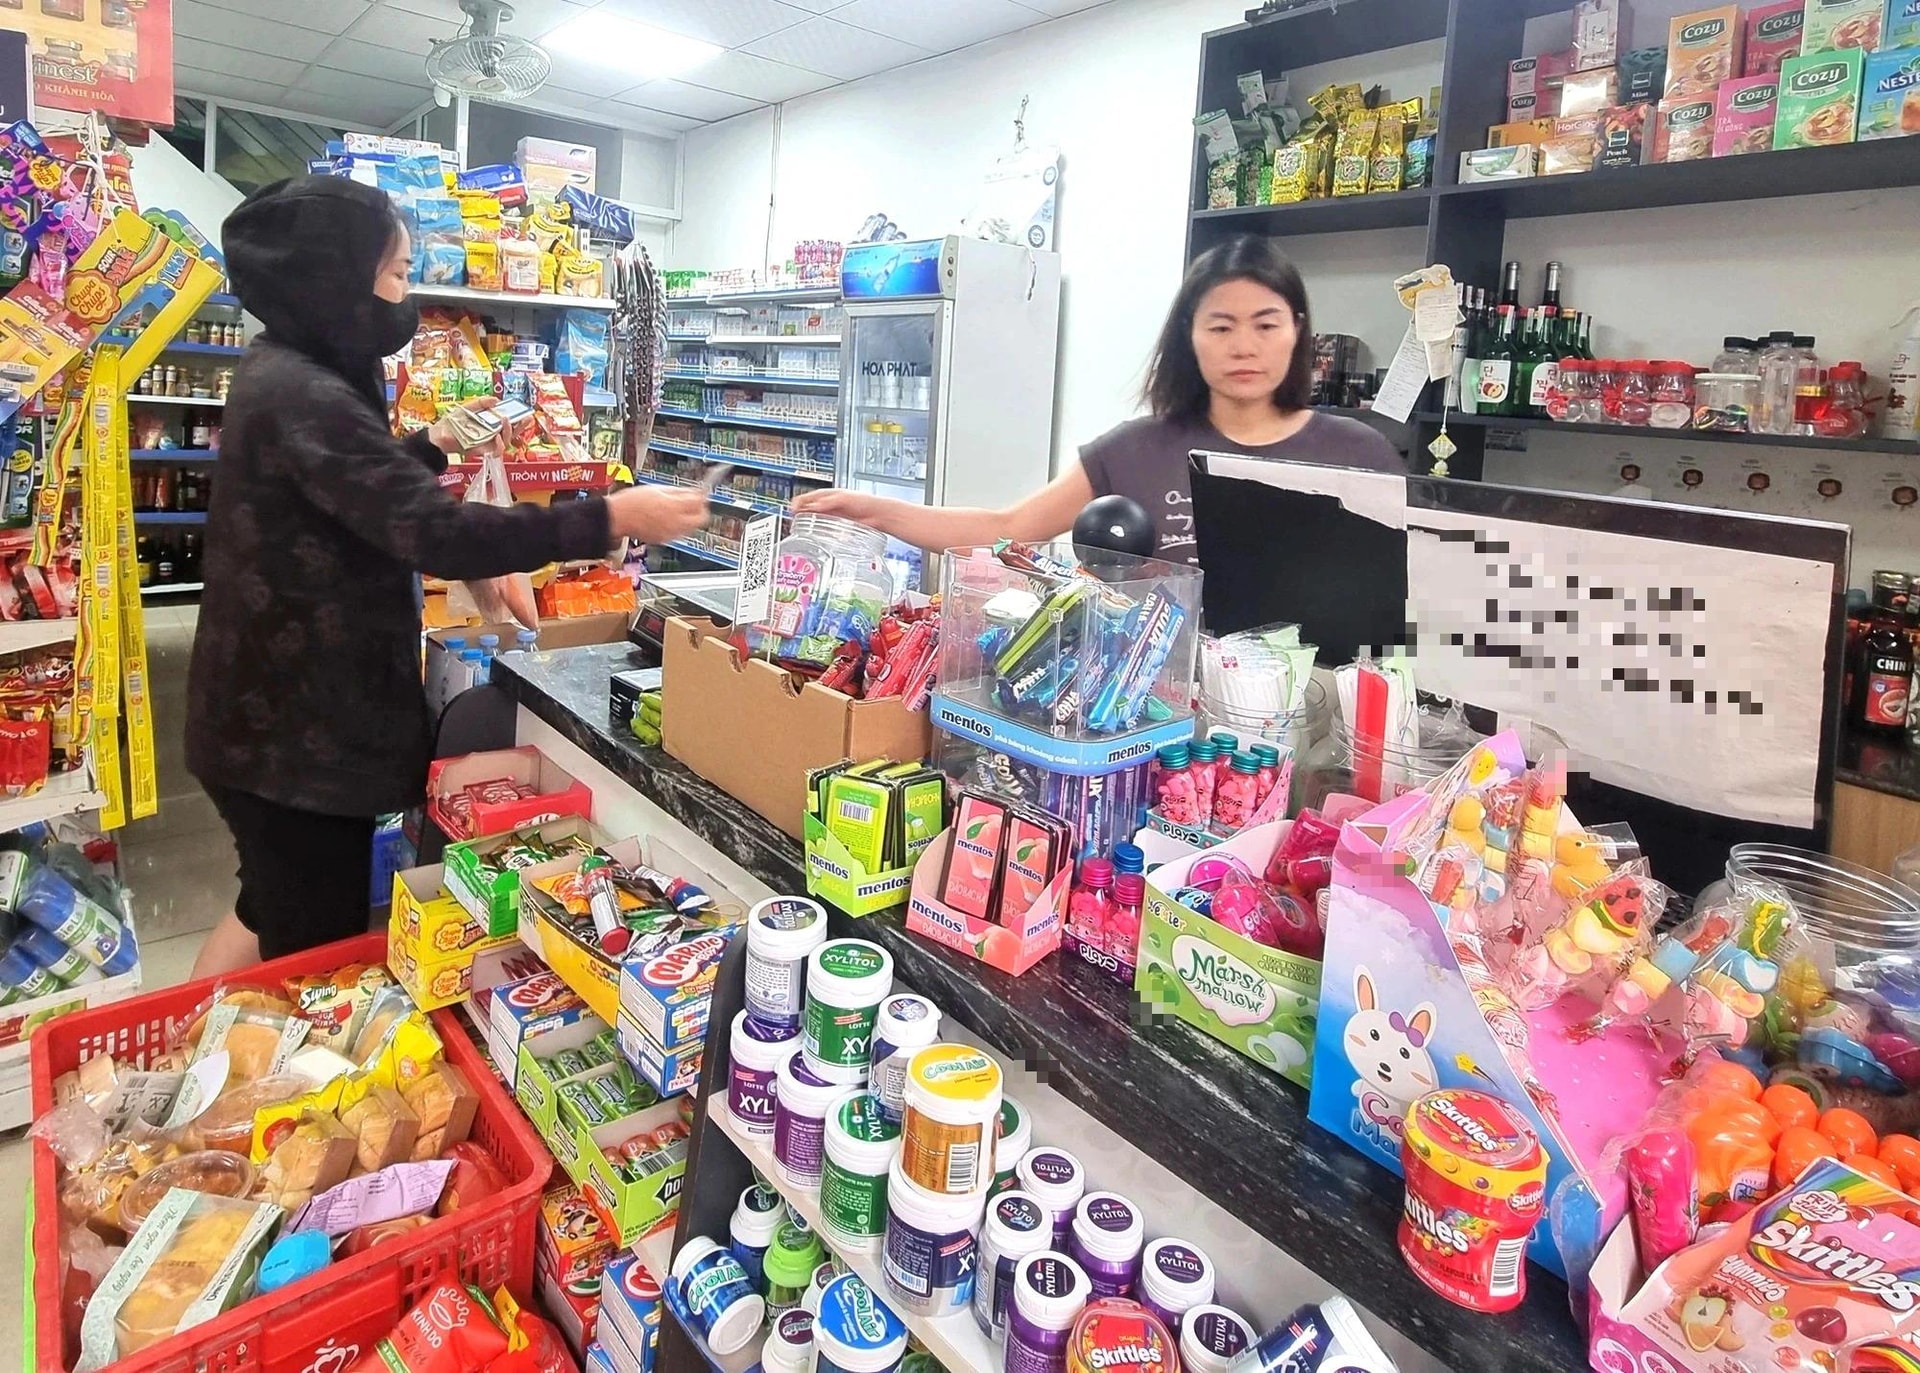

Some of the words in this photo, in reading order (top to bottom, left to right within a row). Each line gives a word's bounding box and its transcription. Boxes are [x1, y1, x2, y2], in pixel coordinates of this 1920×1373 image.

[1684, 22, 1721, 39] Cozy
[1762, 13, 1801, 31] Cozy
[1513, 60, 1534, 71] Cozy
[1797, 68, 1840, 86] Cozy
[1512, 97, 1533, 107] Cozy
[1737, 87, 1771, 103] Cozy
[1672, 105, 1708, 120] Cozy
[940, 708, 993, 738] mentos
[1108, 741, 1151, 763] mentos
[957, 838, 994, 858] mentos
[810, 853, 849, 880] mentos
[1009, 861, 1043, 883] mentos
[858, 876, 911, 896] mentos
[911, 899, 963, 934] mentos
[1026, 911, 1060, 937] mentos
[825, 953, 877, 968] XYLITOL
[300, 982, 338, 1011] Swing
[1430, 1098, 1499, 1152] Skittles
[1035, 1162, 1072, 1174] XYLITOL
[1002, 1202, 1036, 1224] XYLITOL
[1091, 1211, 1130, 1221] XYLITOL
[1160, 1256, 1201, 1273] XYLITOL
[1751, 1219, 1920, 1311] Skittles
[1046, 1261, 1057, 1295] XYLITOL
[1214, 1316, 1228, 1352] XYLITOL
[1090, 1344, 1162, 1369] Skittles
